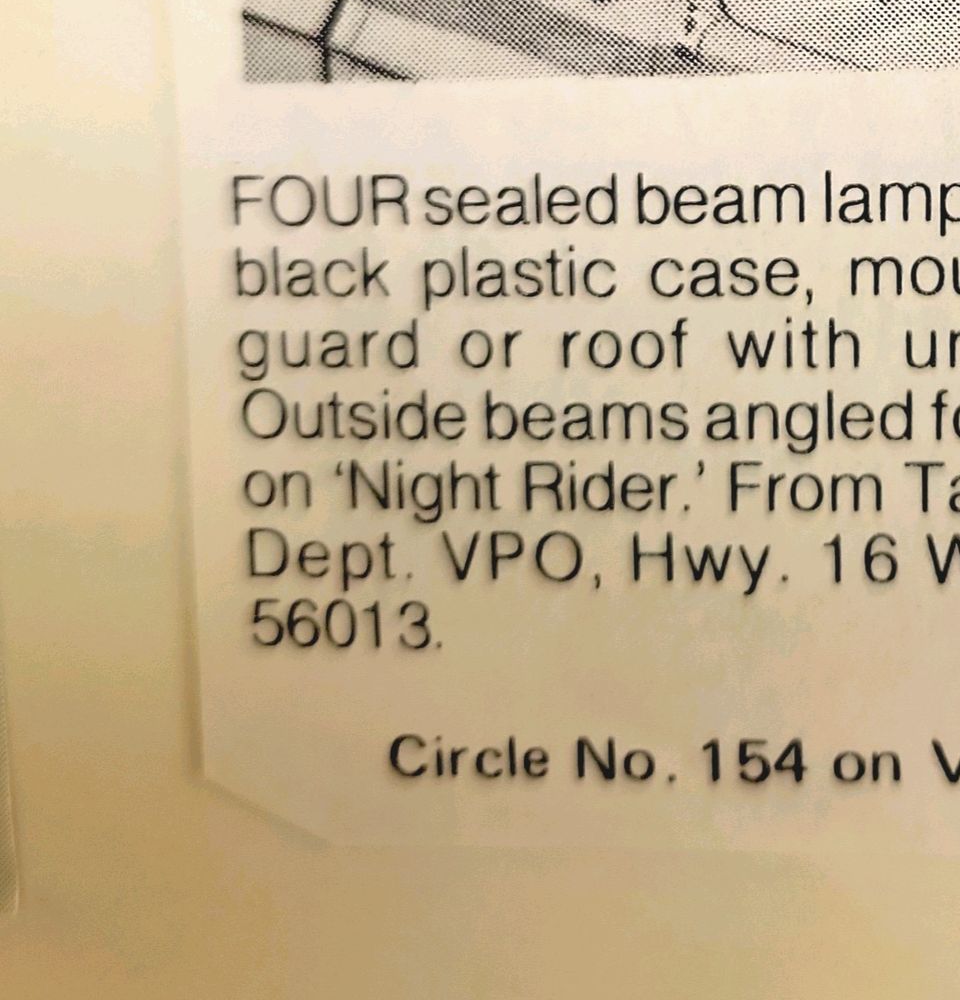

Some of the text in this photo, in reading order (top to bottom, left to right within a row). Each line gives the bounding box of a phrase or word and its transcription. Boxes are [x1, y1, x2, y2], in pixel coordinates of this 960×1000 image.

[229, 173, 410, 228] FOUR
[423, 172, 619, 227] sealed
[635, 171, 806, 226] beam
[232, 246, 390, 299] black
[421, 244, 617, 312] plastic
[648, 256, 814, 307] case,
[234, 317, 419, 383] guard
[458, 329, 523, 371] or
[559, 316, 689, 372] roof
[726, 315, 861, 371] with
[239, 387, 467, 442] Outside
[482, 389, 690, 443] beams
[704, 388, 914, 456] angled
[241, 469, 312, 510] on
[728, 460, 883, 514] From
[245, 527, 415, 593] Dept.
[441, 530, 601, 591] VPO,
[630, 531, 789, 599] Hwy.
[823, 532, 899, 586] 16
[249, 598, 443, 653] 56013.
[387, 733, 550, 782] Circle
[574, 735, 677, 785] No.
[701, 737, 809, 788] 154
[832, 750, 902, 787] on
